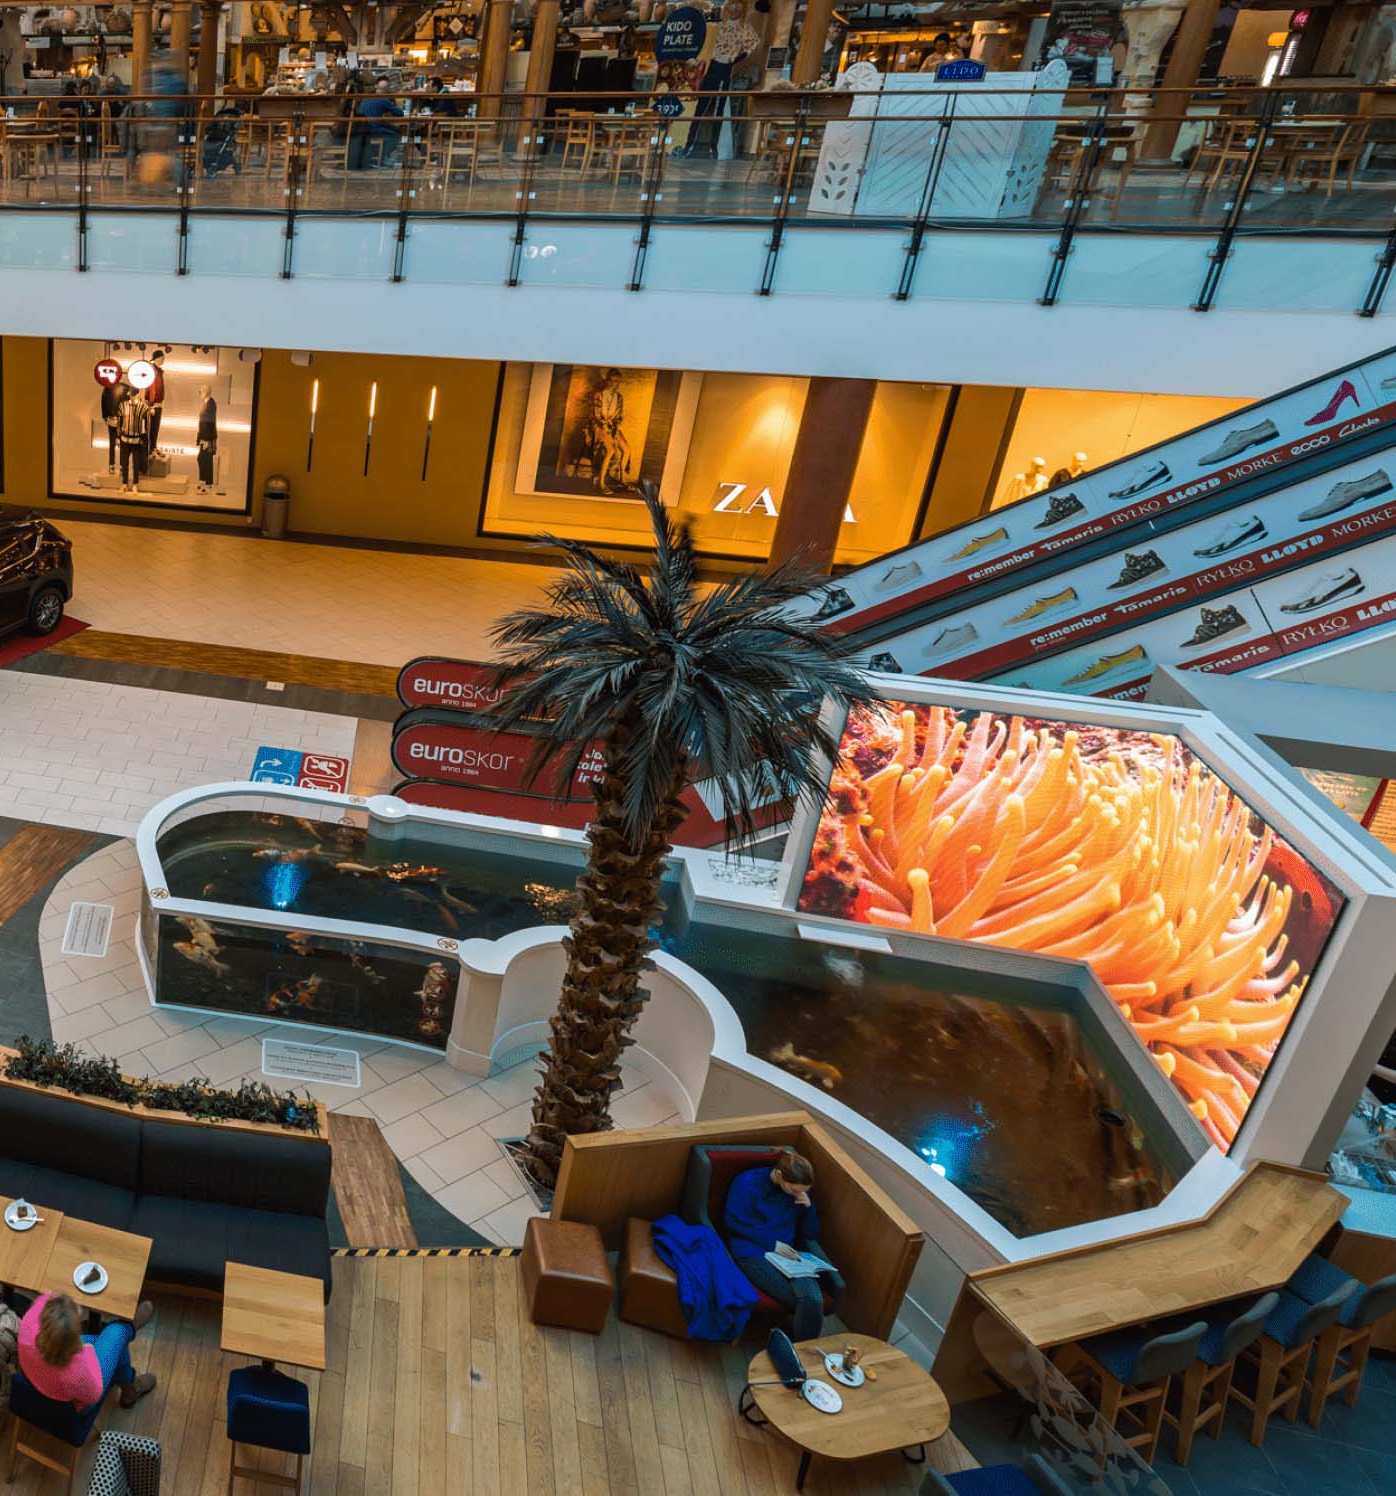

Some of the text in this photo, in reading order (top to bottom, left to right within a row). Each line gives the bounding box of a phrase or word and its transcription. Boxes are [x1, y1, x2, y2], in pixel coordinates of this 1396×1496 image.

[664, 34, 693, 46] PLATE
[666, 21, 693, 32] KIDO
[967, 550, 1036, 581] re:member
[1166, 477, 1221, 503] LLOYD
[1291, 435, 1331, 455] ecco
[1030, 611, 1107, 647] re:member
[1260, 534, 1324, 564] LLOYD
